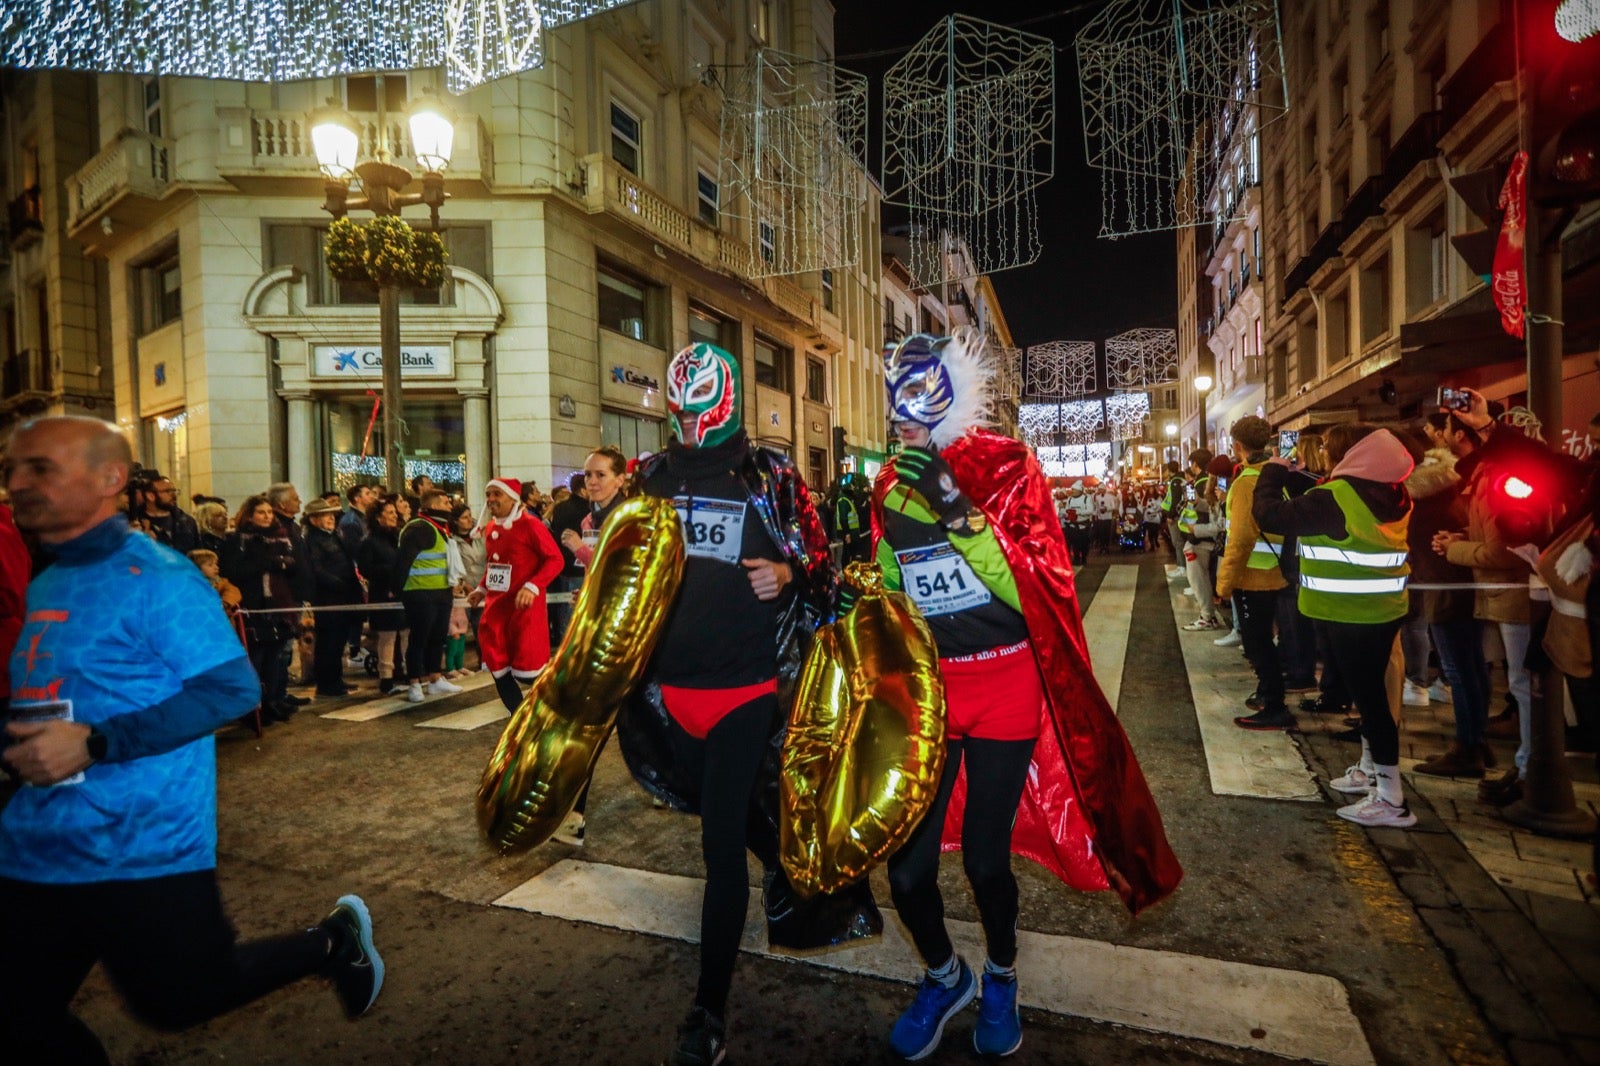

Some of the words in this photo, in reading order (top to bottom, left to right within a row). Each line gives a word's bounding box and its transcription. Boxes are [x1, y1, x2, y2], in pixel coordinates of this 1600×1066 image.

[362, 352, 434, 366] CaBank
[489, 574, 504, 584] 902
[915, 567, 967, 598] 541
[999, 640, 1028, 657] nuevo
